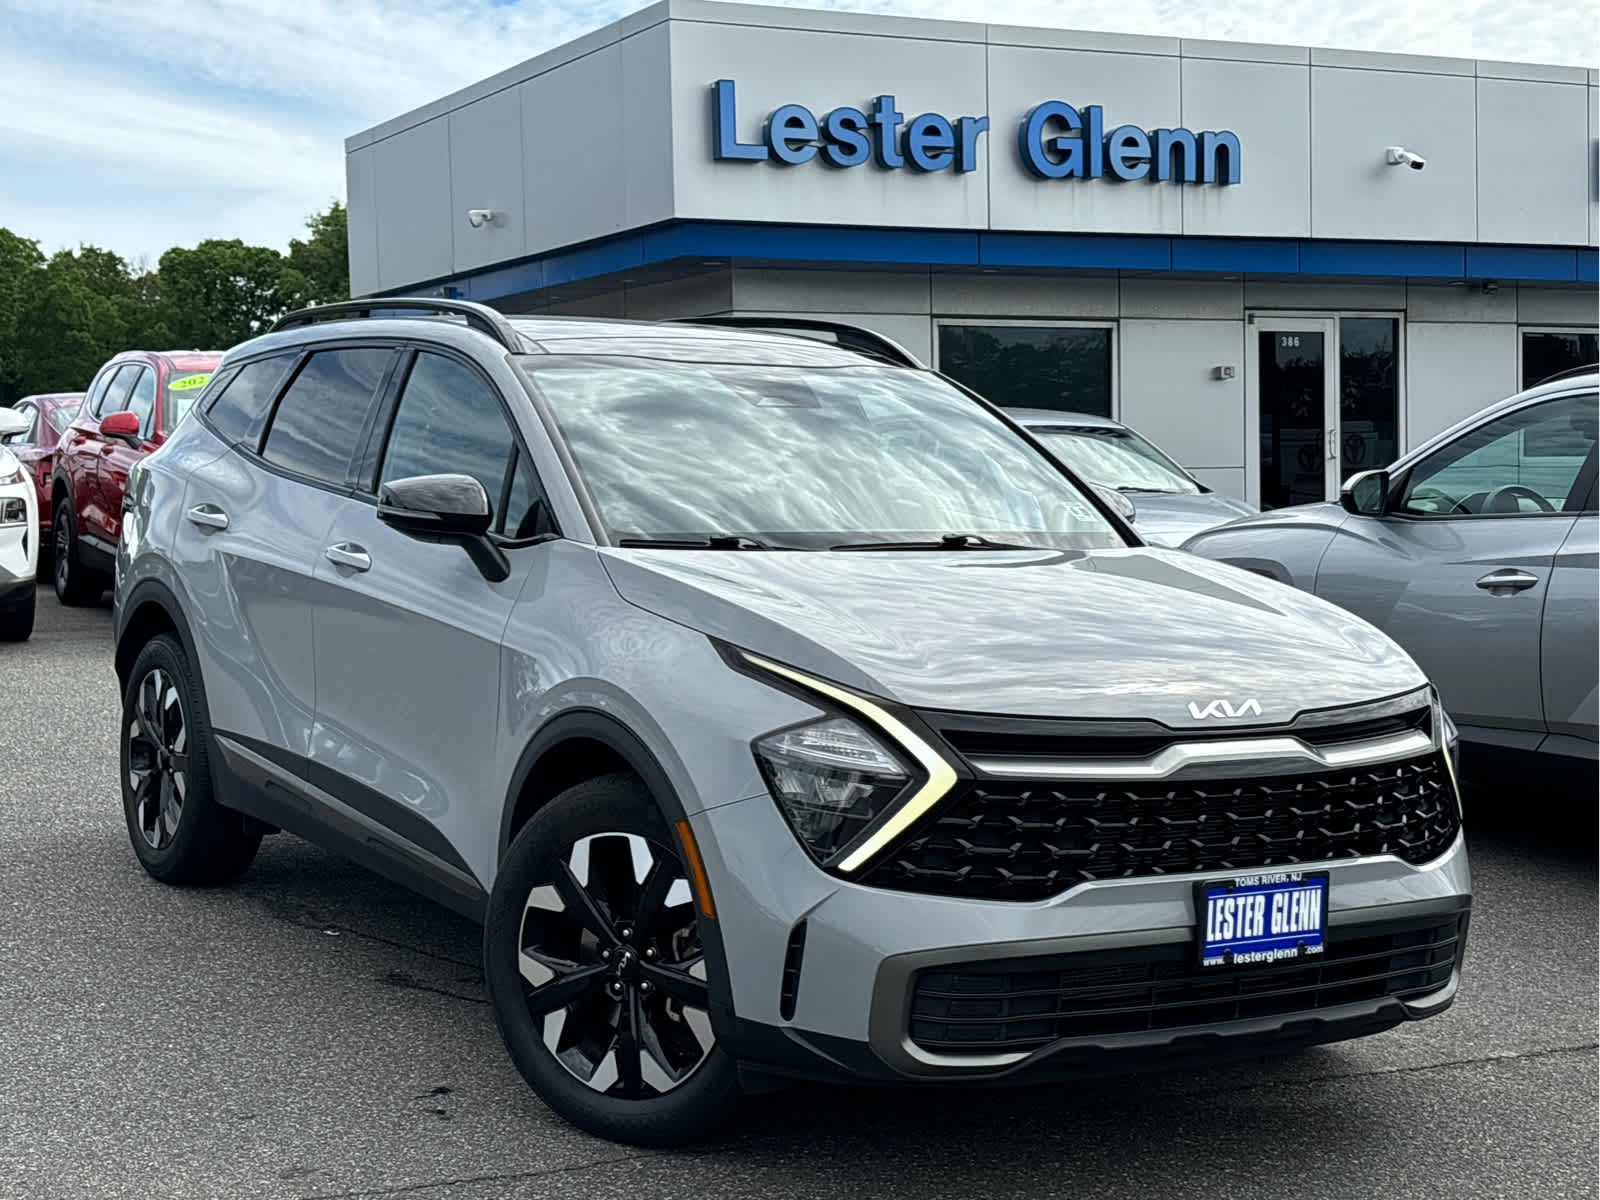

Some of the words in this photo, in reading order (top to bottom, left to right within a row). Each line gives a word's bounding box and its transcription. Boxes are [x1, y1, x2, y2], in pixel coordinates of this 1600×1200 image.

[712, 78, 989, 173] Lester
[1020, 99, 1241, 184] Glenn
[1281, 336, 1300, 347] 386
[180, 375, 209, 388] 202
[1187, 698, 1262, 719] KIA
[1235, 876, 1260, 887] TOMS
[1261, 873, 1289, 885] RIVER,
[1291, 872, 1303, 881] NJ
[1206, 895, 1265, 942] LESTER
[1271, 889, 1321, 934] GLENN
[1233, 947, 1298, 964] lesterglenn
